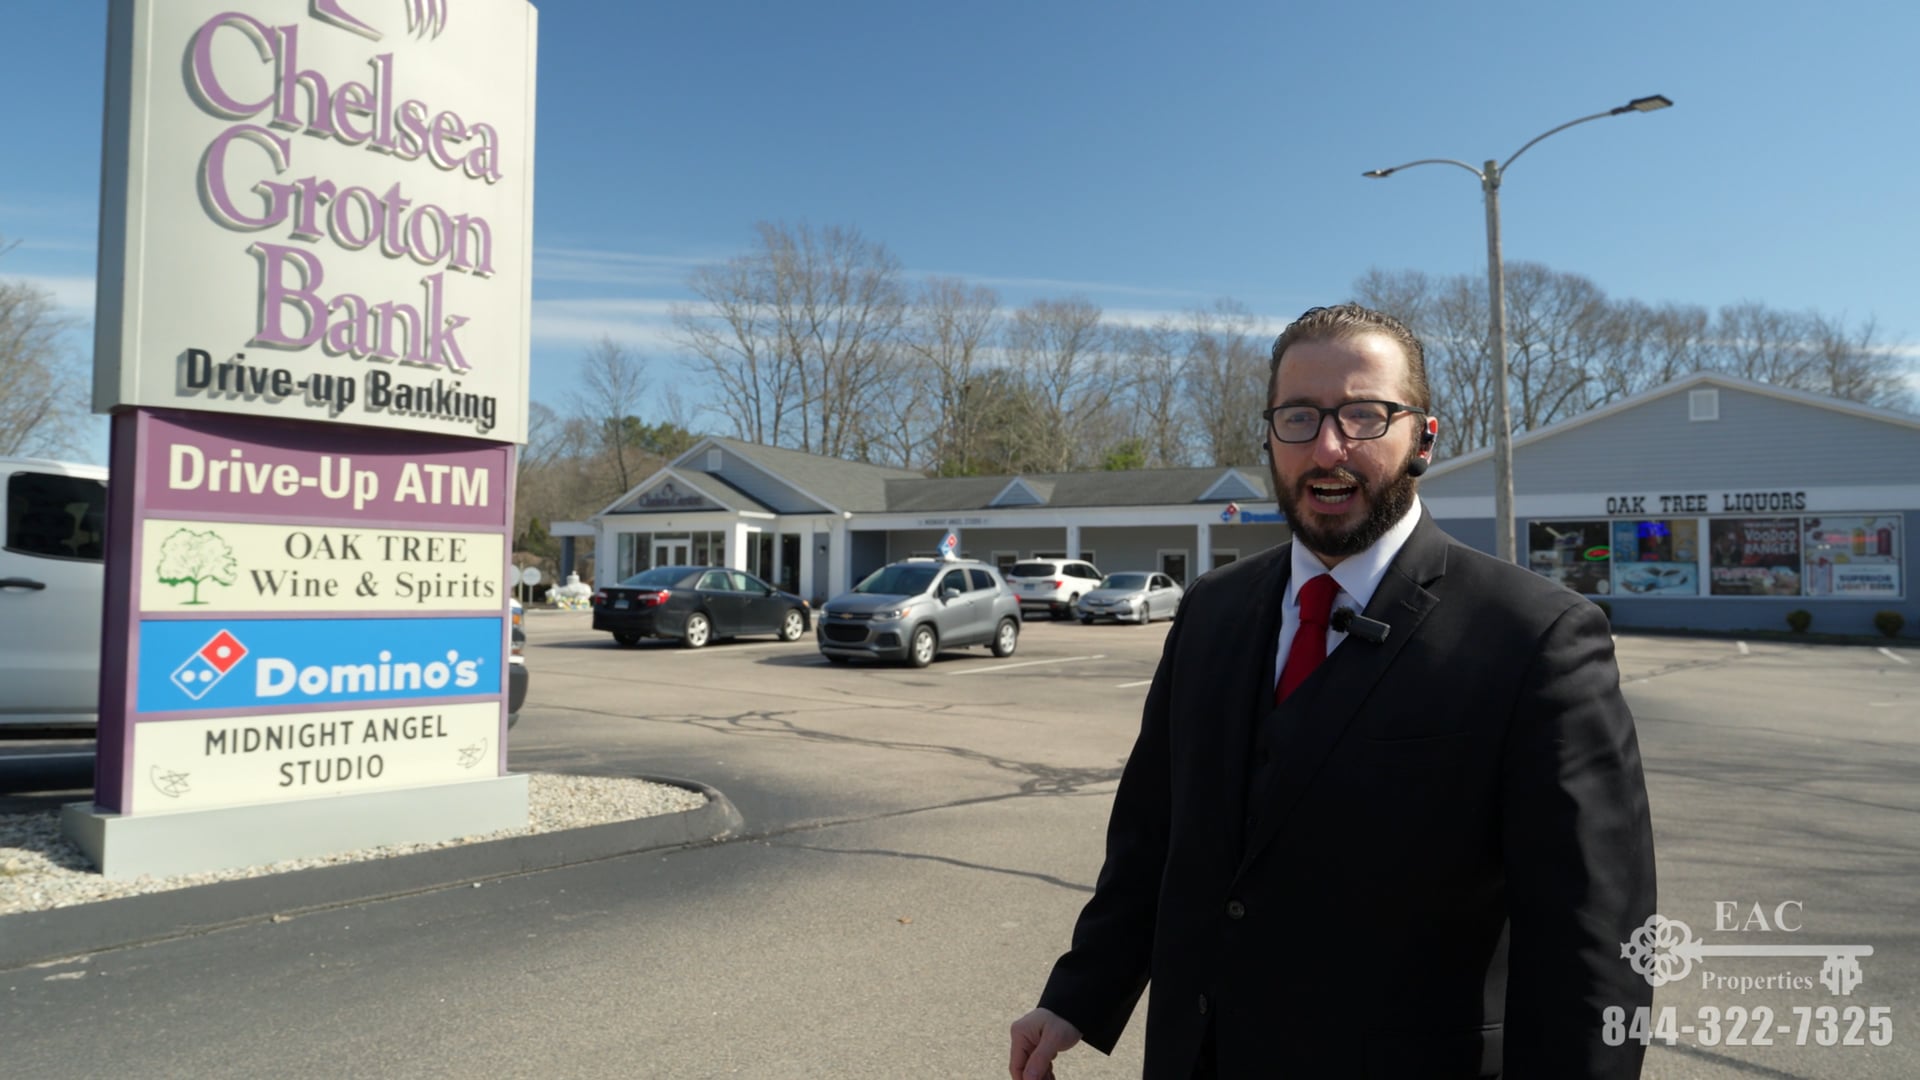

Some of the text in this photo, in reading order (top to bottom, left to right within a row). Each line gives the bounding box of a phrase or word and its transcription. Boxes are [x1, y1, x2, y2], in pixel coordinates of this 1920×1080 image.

[183, 11, 503, 184] Chelsea
[197, 124, 496, 278] Groton
[245, 241, 473, 375] Bank
[182, 348, 497, 430] Drive-up Banking
[168, 444, 490, 510] Drive-Up ATM
[1606, 492, 1806, 515] OAK TREE LIQUORS
[285, 531, 468, 563] OAK TREE
[251, 569, 496, 604] Wine & Spirits
[256, 649, 479, 697] Domino's
[205, 714, 448, 756] MIDNIGHT ANGEL
[279, 754, 384, 787] STUDIO
